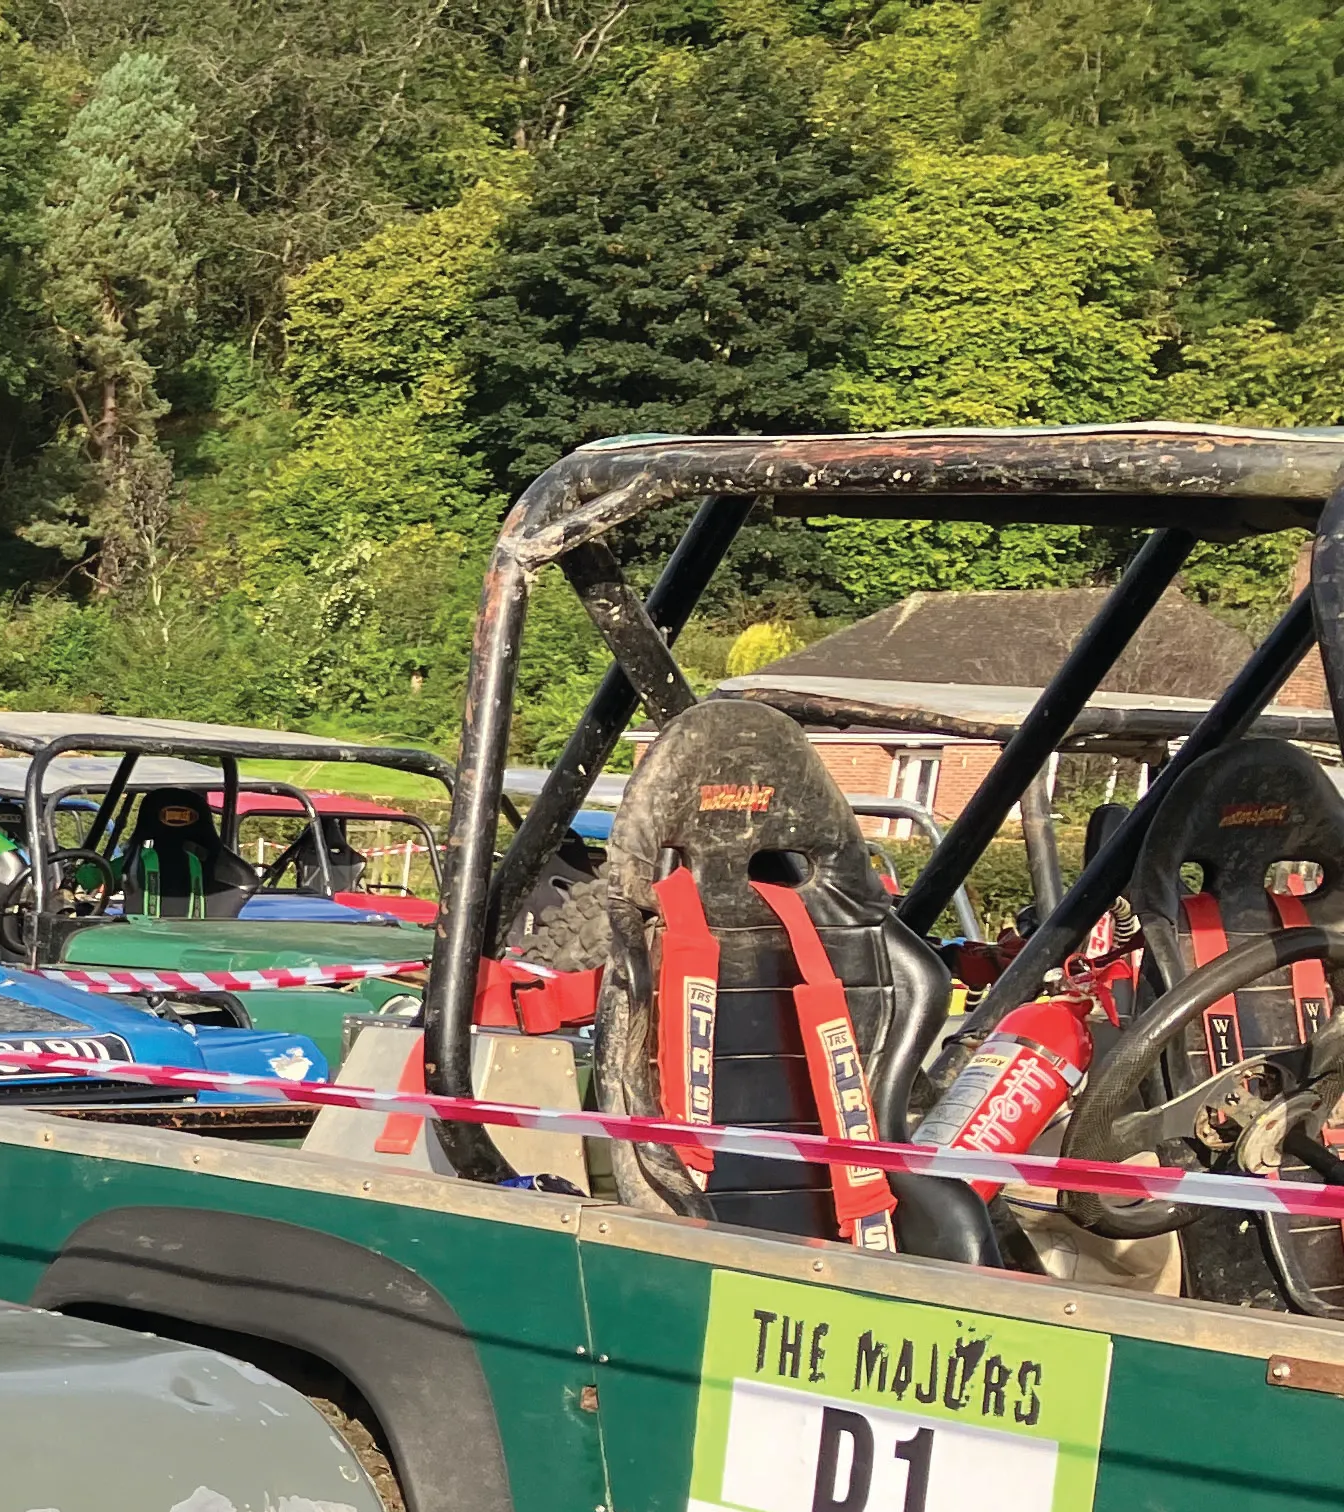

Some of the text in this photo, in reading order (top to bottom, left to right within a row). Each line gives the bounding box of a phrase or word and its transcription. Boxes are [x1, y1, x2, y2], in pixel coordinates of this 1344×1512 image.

[690, 987, 711, 1004] TRS
[692, 1009, 712, 1111] TRS
[826, 1032, 848, 1048] TRS
[834, 1053, 872, 1141] TRS
[753, 1308, 1042, 1426] THE MAJORS
